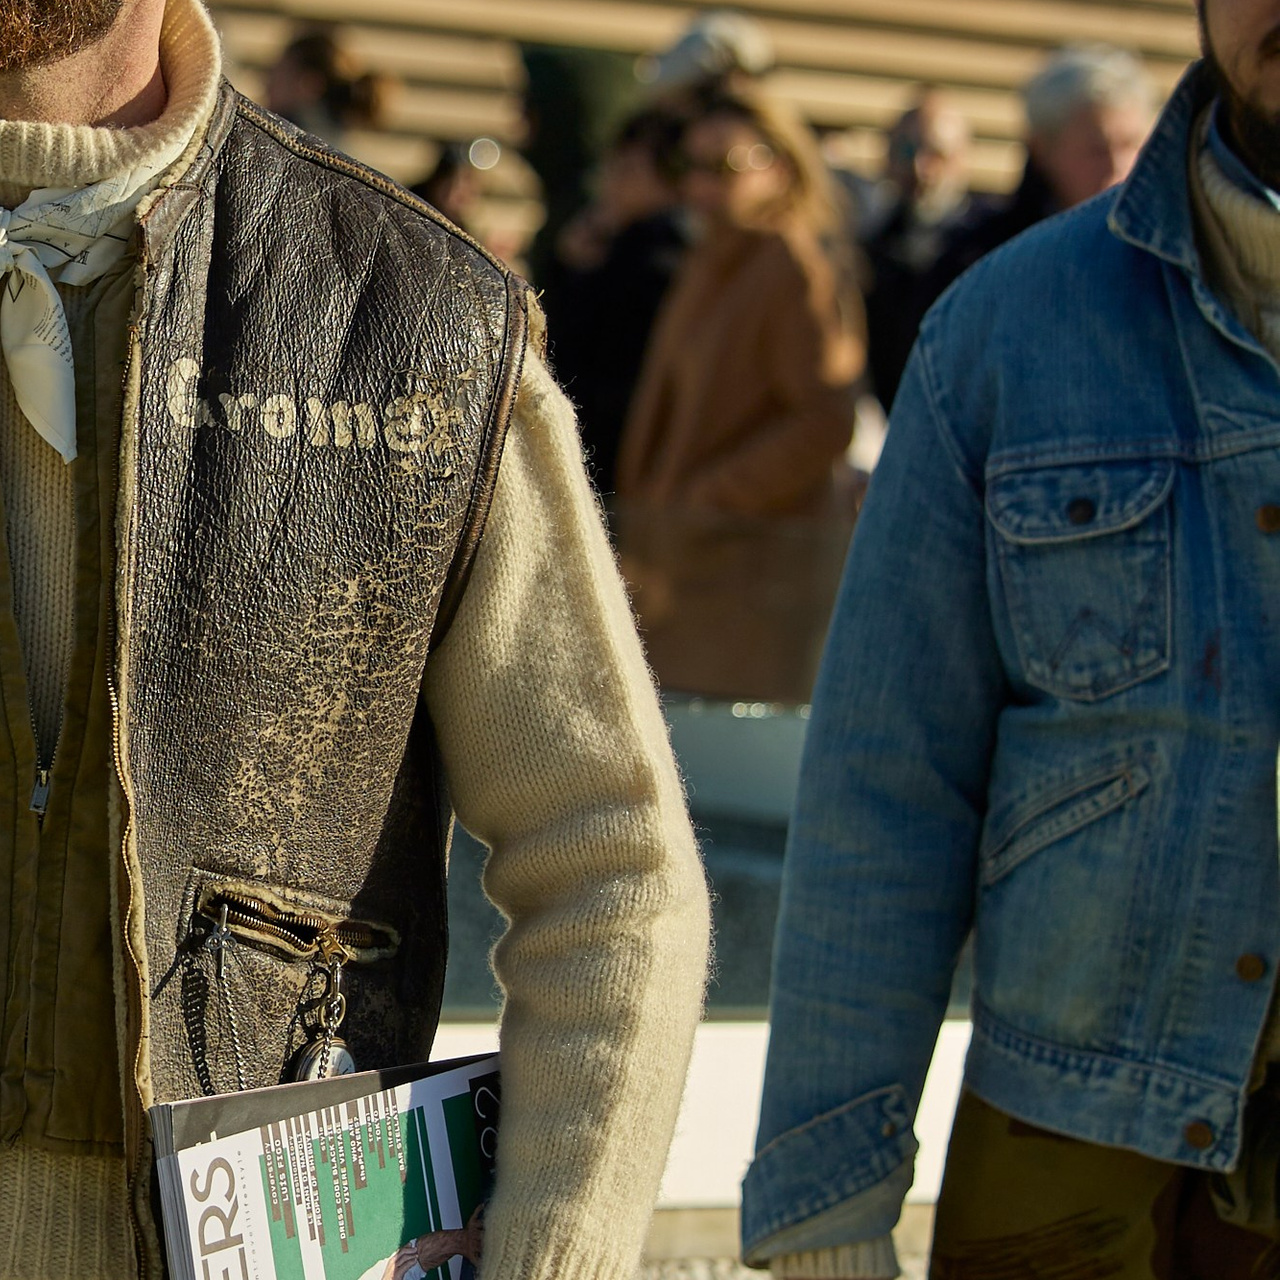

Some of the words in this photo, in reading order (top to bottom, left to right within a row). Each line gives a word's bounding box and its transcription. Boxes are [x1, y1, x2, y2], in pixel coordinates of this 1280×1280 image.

[335, 1122, 345, 1164] VINTAGE
[373, 1110, 381, 1142] TOKYO
[275, 1140, 284, 1168] FIGO
[289, 1135, 301, 1199] fashionstory
[296, 1133, 305, 1168] NAPOLI
[305, 1130, 316, 1172] SHIBUYA
[329, 1144, 338, 1176] BLACK
[350, 1141, 358, 1162] WHO
[397, 1152, 405, 1171] BAR
[265, 1142, 278, 1205] coverstory
[340, 1166, 350, 1204] VIVERE
[312, 1189, 323, 1226] PEOPLE
[333, 1179, 342, 1204] CODE
[336, 1207, 346, 1240] DRESS
